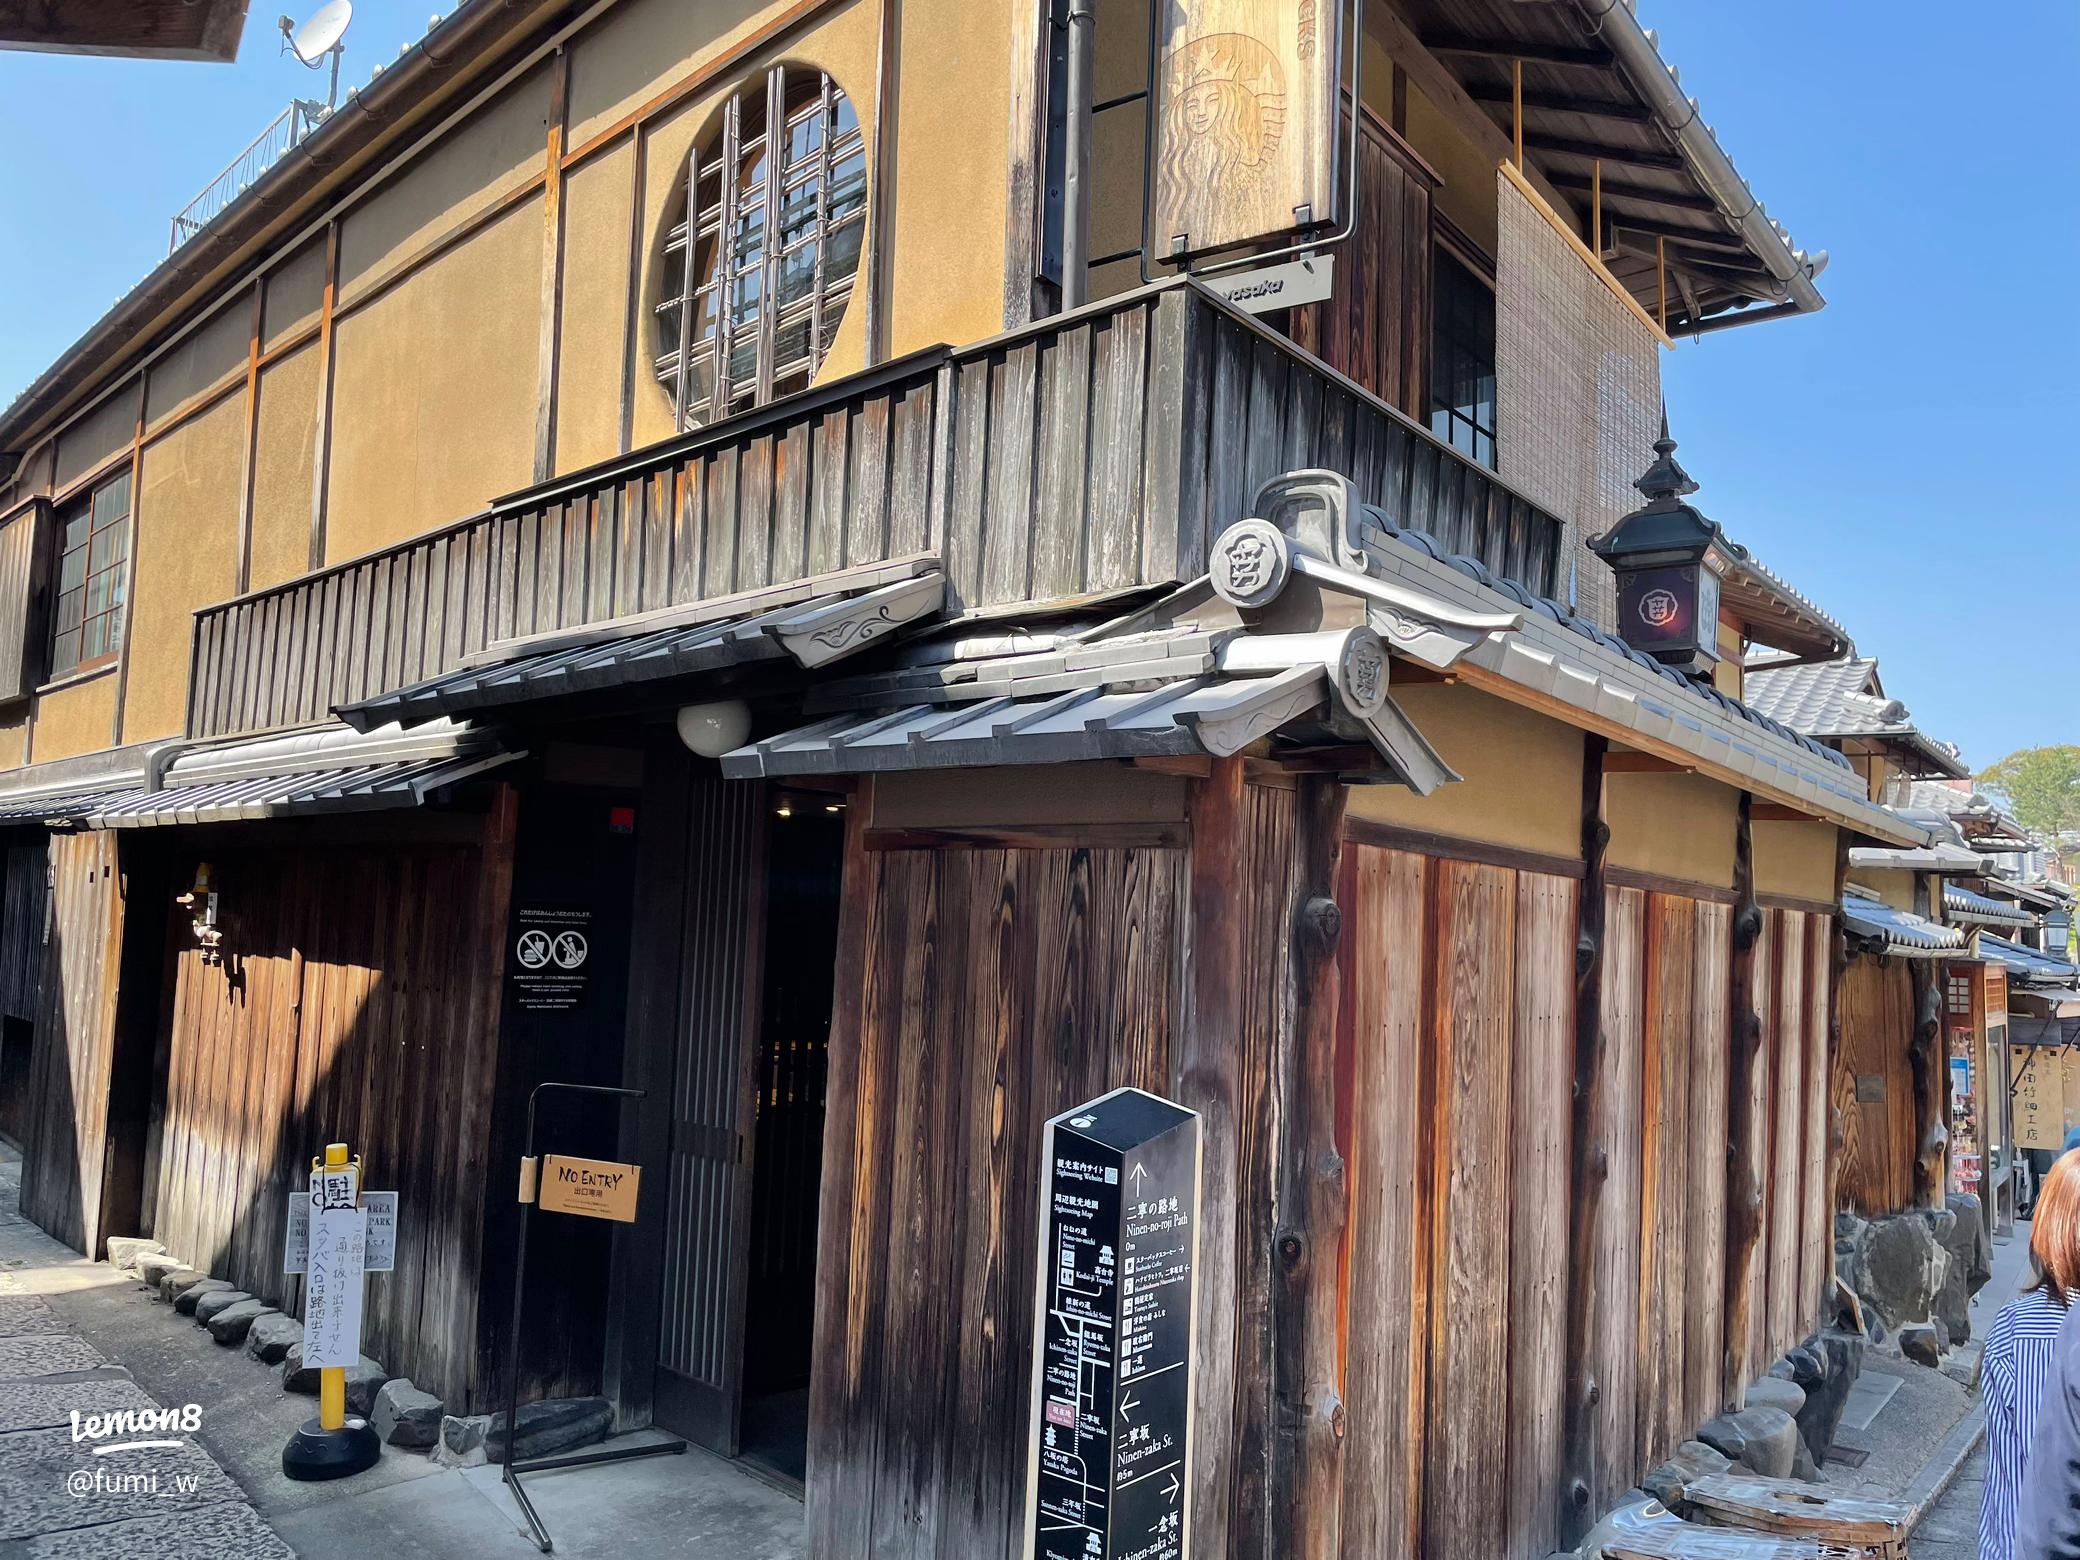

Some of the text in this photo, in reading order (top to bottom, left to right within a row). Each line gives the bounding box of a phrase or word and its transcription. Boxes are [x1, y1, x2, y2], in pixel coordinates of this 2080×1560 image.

[1057, 1158, 1103, 1174] 観光案内サイト
[559, 1167, 623, 1191] NO ENTRY
[574, 1187, 602, 1198] 出口専用
[1081, 1209, 1093, 1219] Map
[1174, 1211, 1188, 1227] Path
[1118, 1423, 1150, 1449] 二寧坂
[1118, 1434, 1173, 1467] Ninen-zaka St.
[1148, 1510, 1178, 1533] 一念坂
[1167, 1530, 1178, 1545] St.
